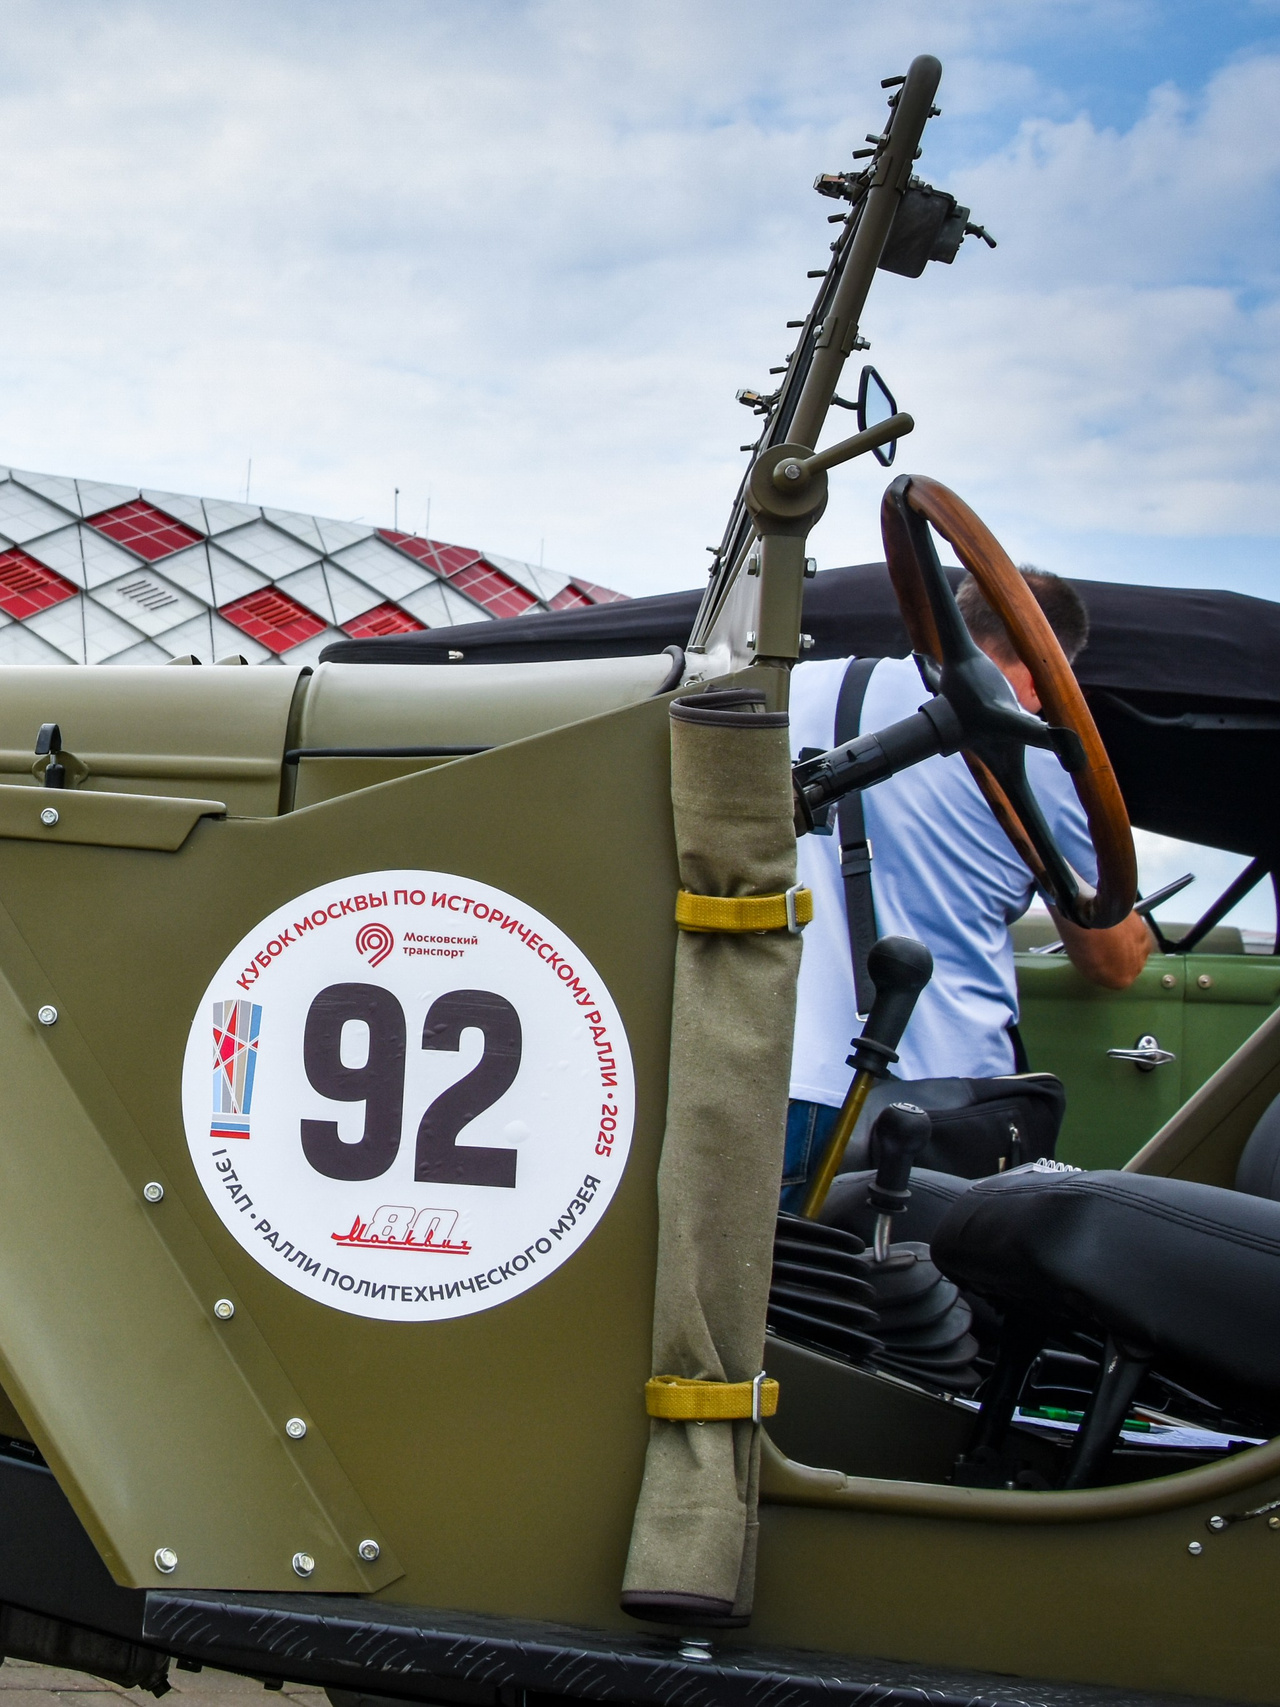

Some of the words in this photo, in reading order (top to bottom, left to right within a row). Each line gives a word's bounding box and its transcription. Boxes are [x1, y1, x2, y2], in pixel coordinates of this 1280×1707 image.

[293, 890, 389, 937] МОСКВЫ
[393, 889, 426, 906] ПО
[236, 928, 297, 991] КУБОК
[403, 931, 478, 945] Московский
[403, 946, 465, 959] транспорт
[430, 890, 596, 1006] ИСТОРИЧЕСКОМУ
[584, 1010, 618, 1087] РАЛЛИ
[300, 982, 523, 1189] 92
[594, 1103, 618, 1158] 2025
[215, 1157, 254, 1213] ЭТАП
[253, 1218, 322, 1277] РАЛЛИ
[321, 1237, 552, 1302] ПОЛИТЕХНИЧЕСКОГО
[548, 1174, 602, 1241] МУЗЕЯ
[364, 1204, 459, 1241] 80
